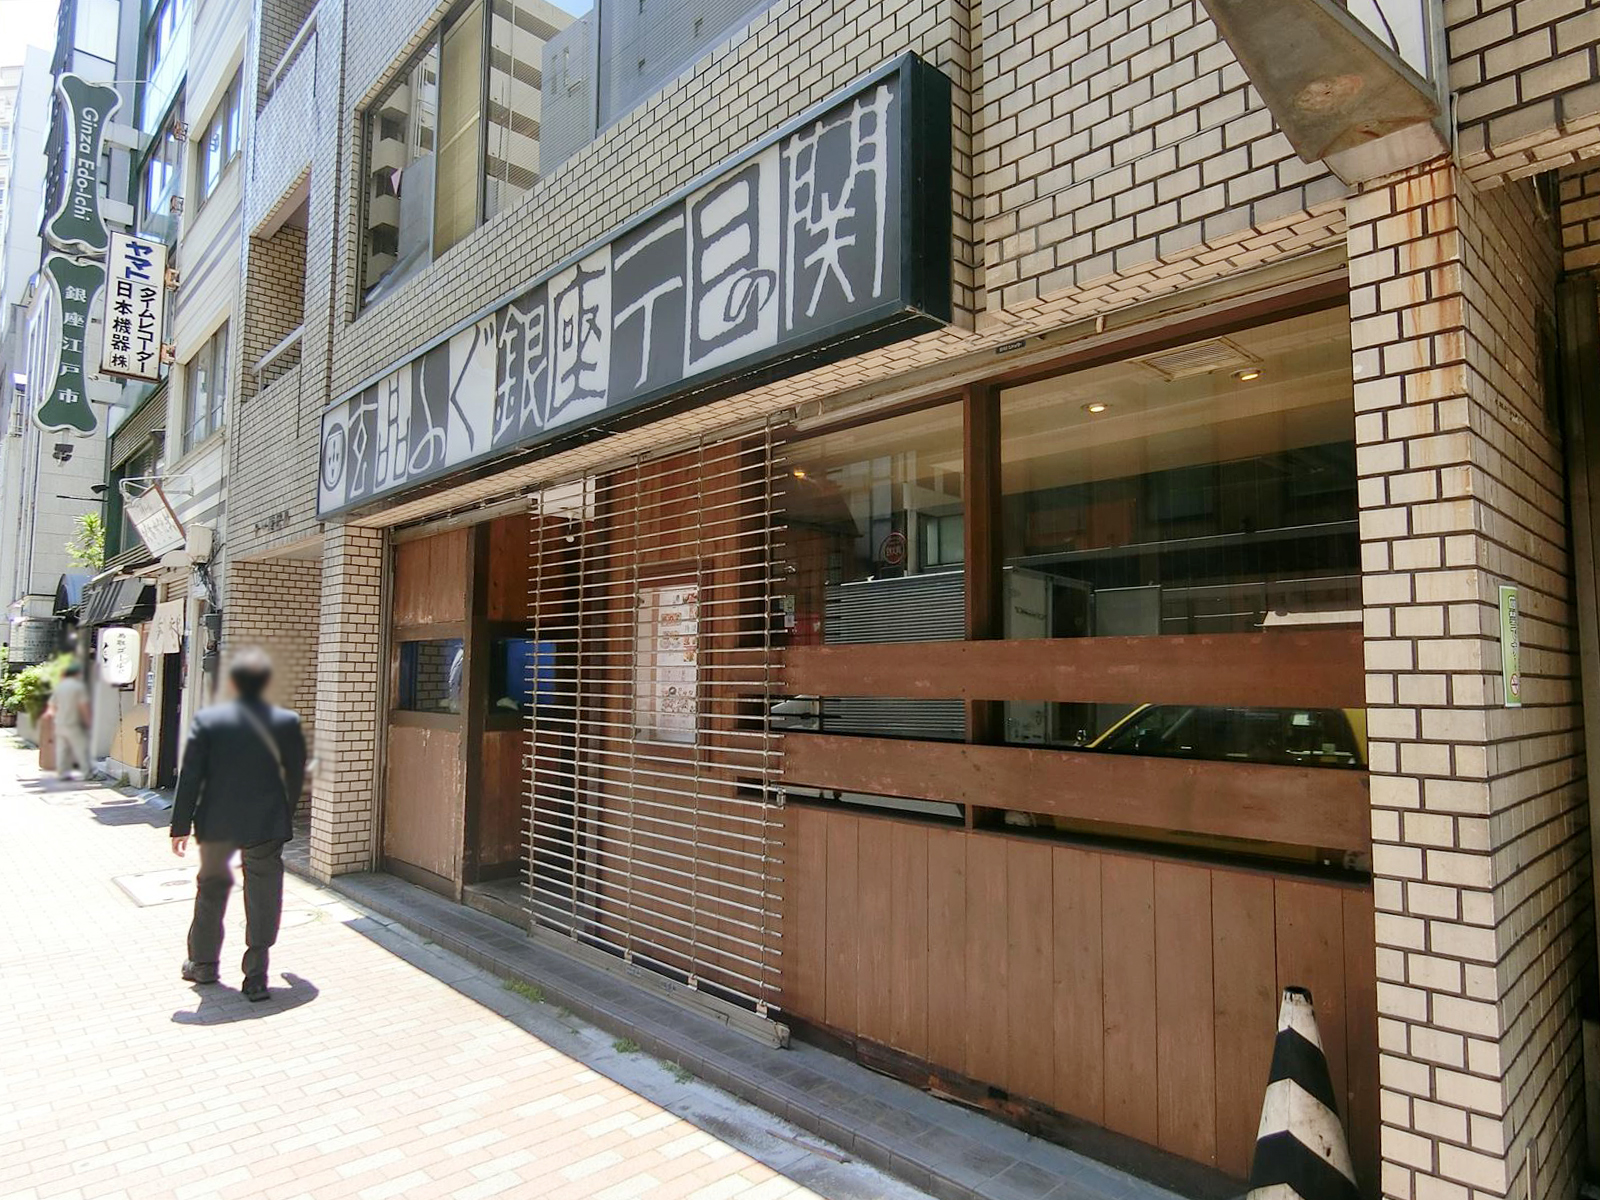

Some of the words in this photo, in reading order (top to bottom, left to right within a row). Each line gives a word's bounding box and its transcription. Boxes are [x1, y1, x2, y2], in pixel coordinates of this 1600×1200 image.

[80, 107, 98, 154] Ginza
[74, 158, 95, 222] Edo-Ichi
[125, 241, 154, 280] ヤマト
[57, 285, 87, 404] 銀座江戸市
[136, 287, 157, 373] タイムレコーダー
